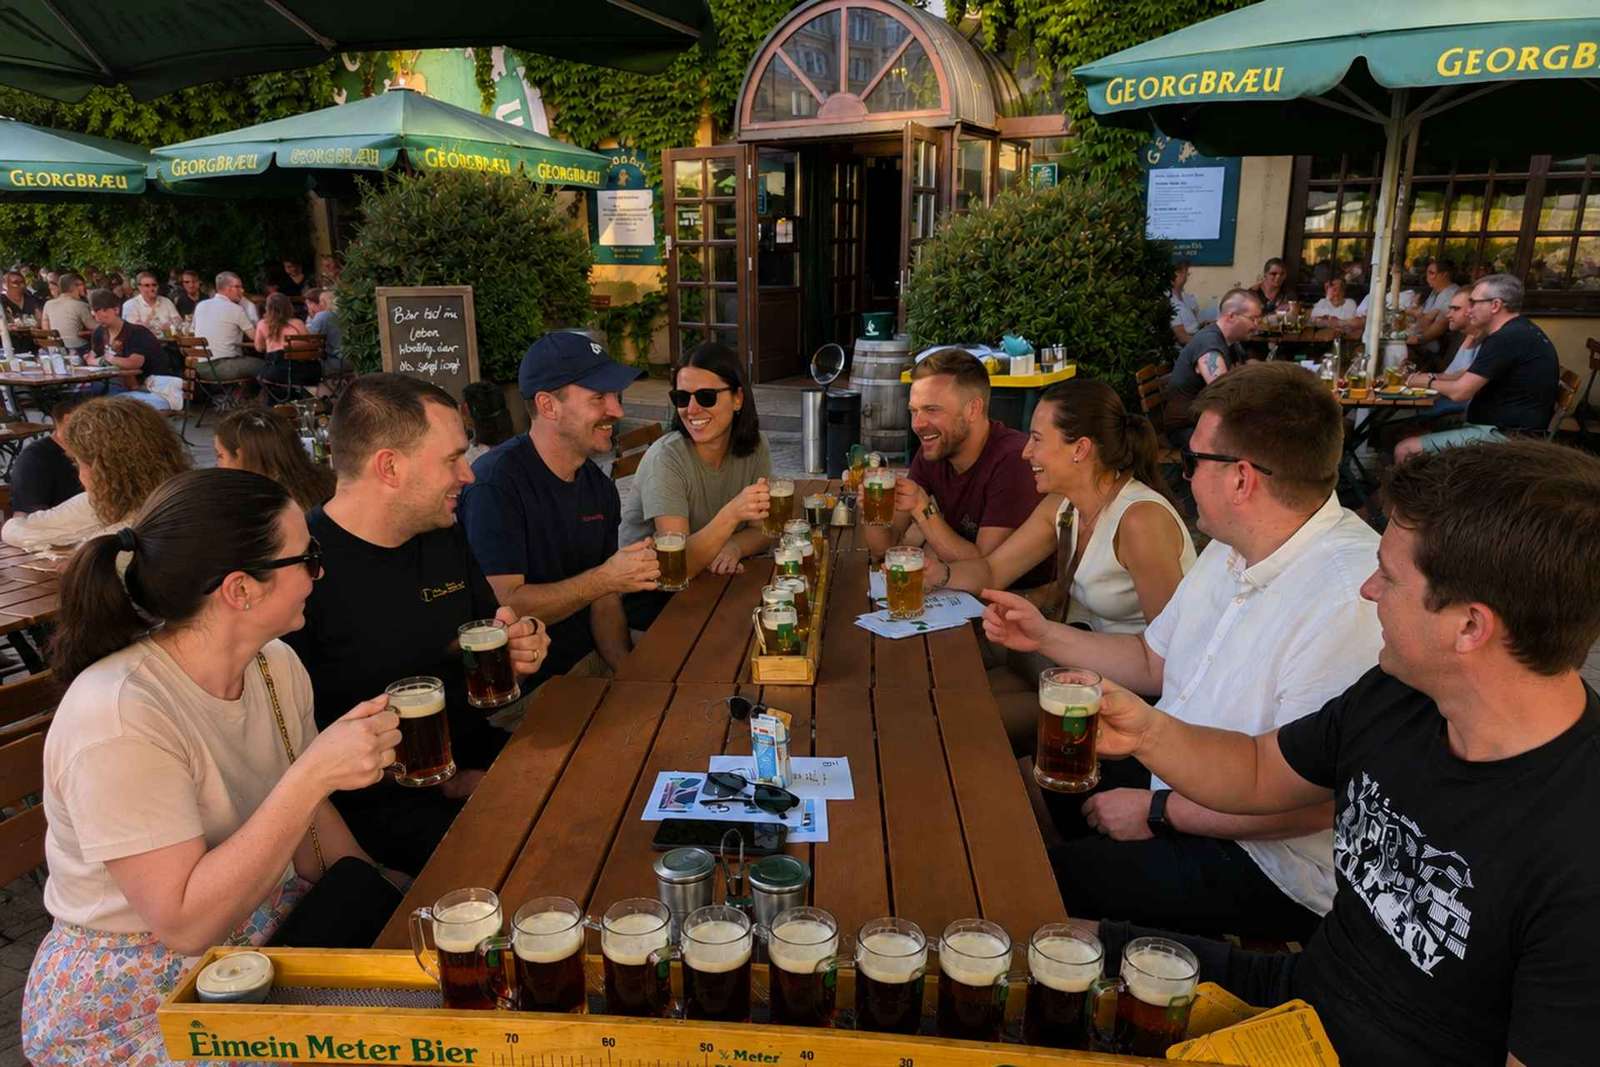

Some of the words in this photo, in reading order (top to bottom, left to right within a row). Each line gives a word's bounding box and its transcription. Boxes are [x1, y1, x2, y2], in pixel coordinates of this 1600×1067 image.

[1436, 42, 1600, 77] GEORGB
[1105, 67, 1285, 106] GEORGBRÆU
[9, 169, 129, 190] GEORGBRÆU
[306, 1034, 401, 1061] Meter
[410, 1038, 478, 1064] Bier
[505, 1033, 519, 1044] 70
[800, 1050, 815, 1061] 40
